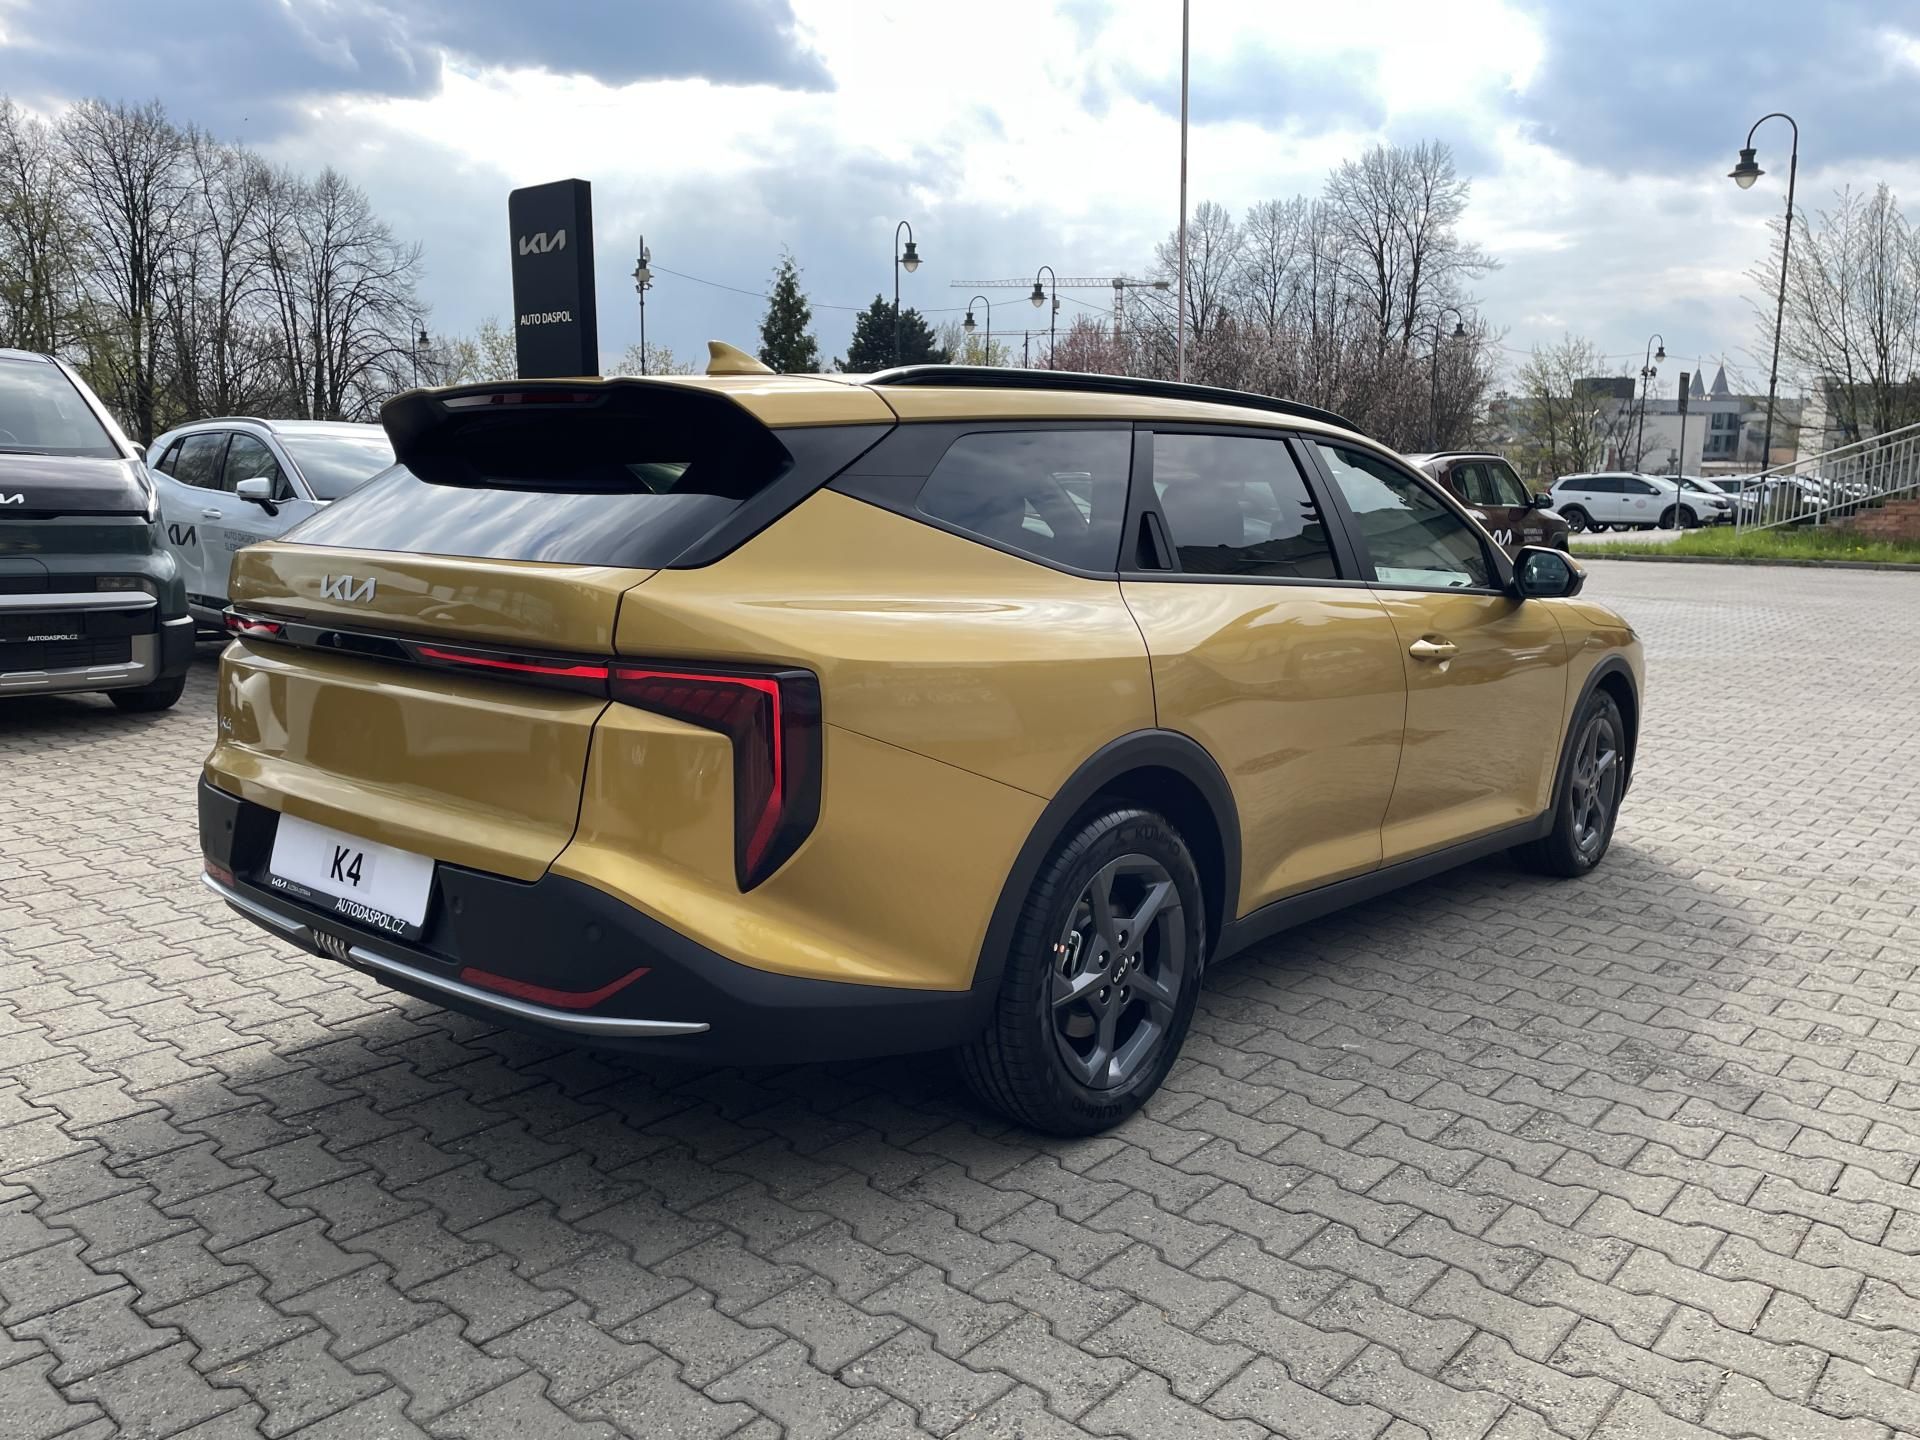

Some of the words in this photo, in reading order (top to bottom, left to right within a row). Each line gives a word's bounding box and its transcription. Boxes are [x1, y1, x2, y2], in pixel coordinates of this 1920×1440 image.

[519, 229, 567, 256] KIA
[520, 313, 541, 326] AUTO
[542, 311, 573, 324] DASPOL
[320, 574, 376, 603] KIA
[330, 845, 364, 887] K4
[271, 877, 288, 889] KIA
[334, 898, 406, 935] AUTODASPOL.CZ
